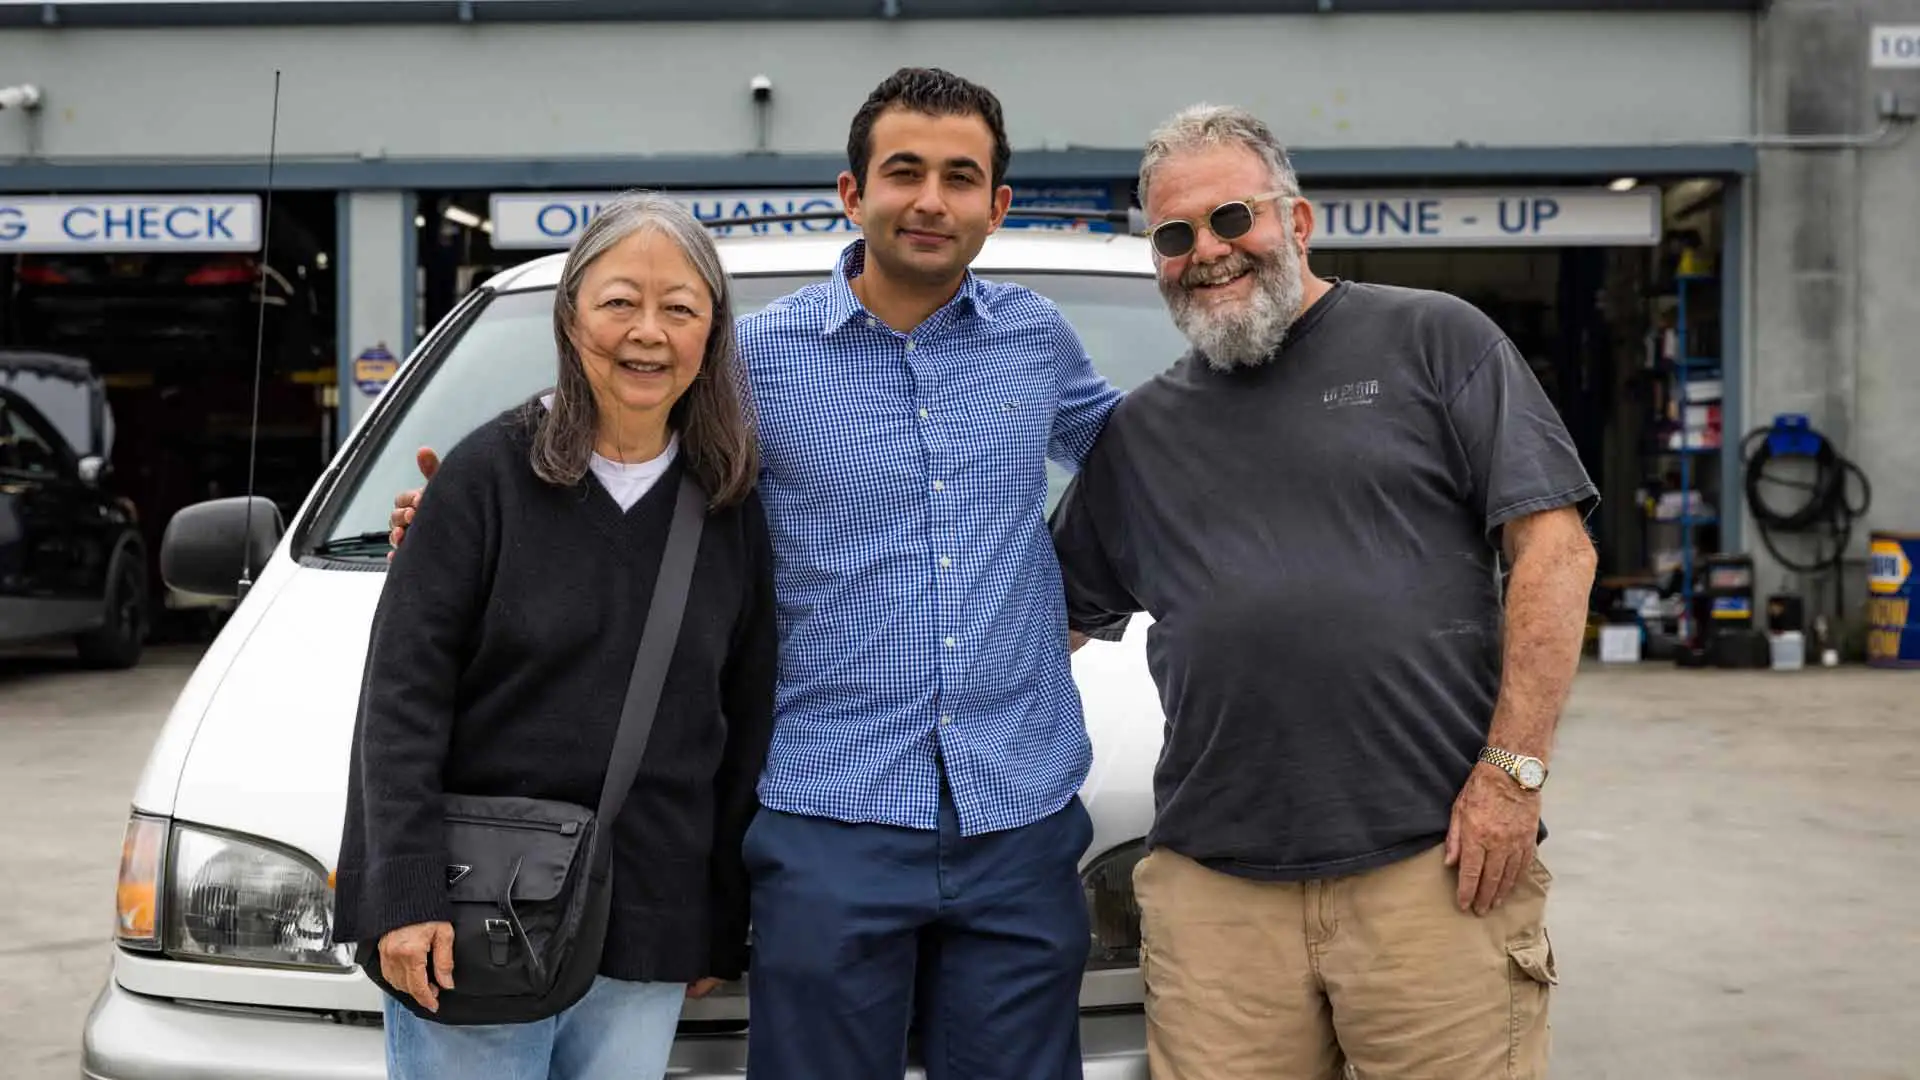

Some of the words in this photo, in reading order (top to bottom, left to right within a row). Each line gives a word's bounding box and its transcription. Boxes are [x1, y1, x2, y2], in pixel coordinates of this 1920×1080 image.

[62, 206, 235, 240] CHECK
[537, 204, 601, 236] OI
[1320, 200, 1442, 235] TUNE
[1499, 198, 1560, 233] UP
